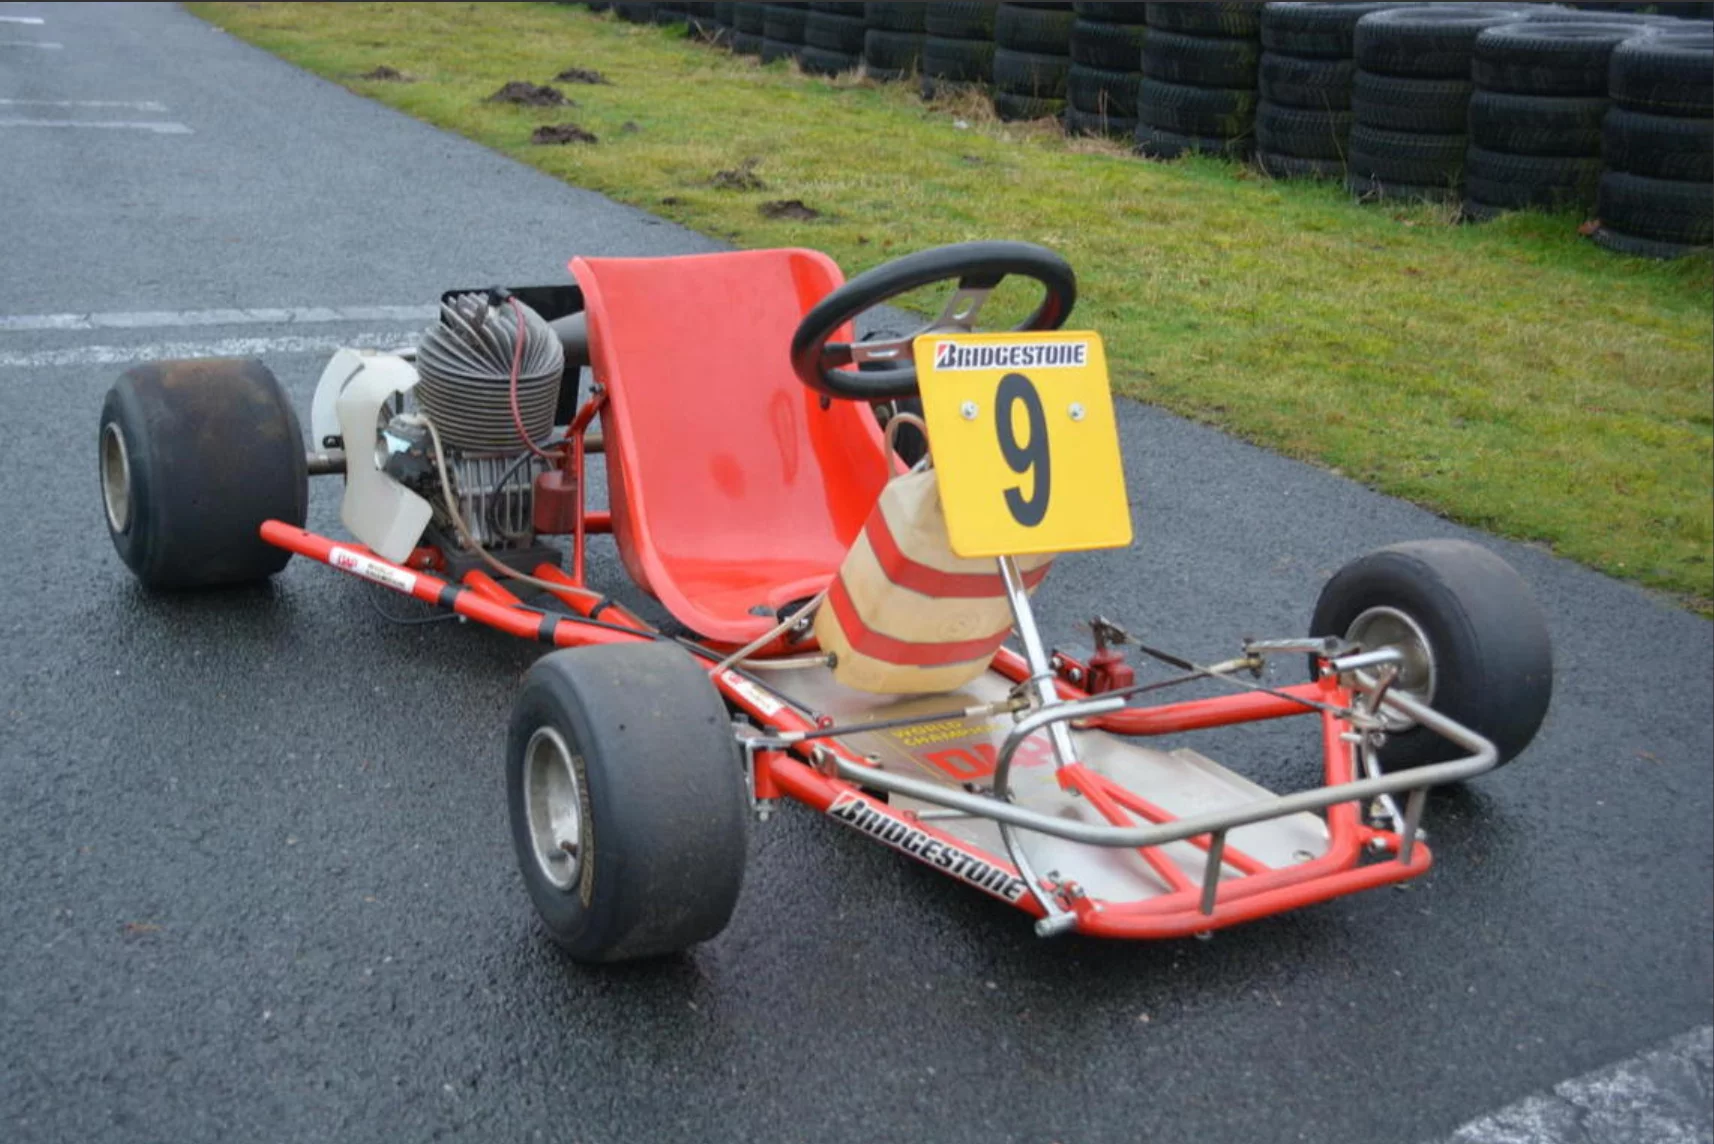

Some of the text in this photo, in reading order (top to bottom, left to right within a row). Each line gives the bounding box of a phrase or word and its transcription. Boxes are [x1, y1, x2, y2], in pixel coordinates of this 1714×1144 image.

[936, 343, 1085, 368] BRIDGESTONE
[994, 372, 1051, 528] 9
[834, 796, 1026, 899] BRIDGESTONE
